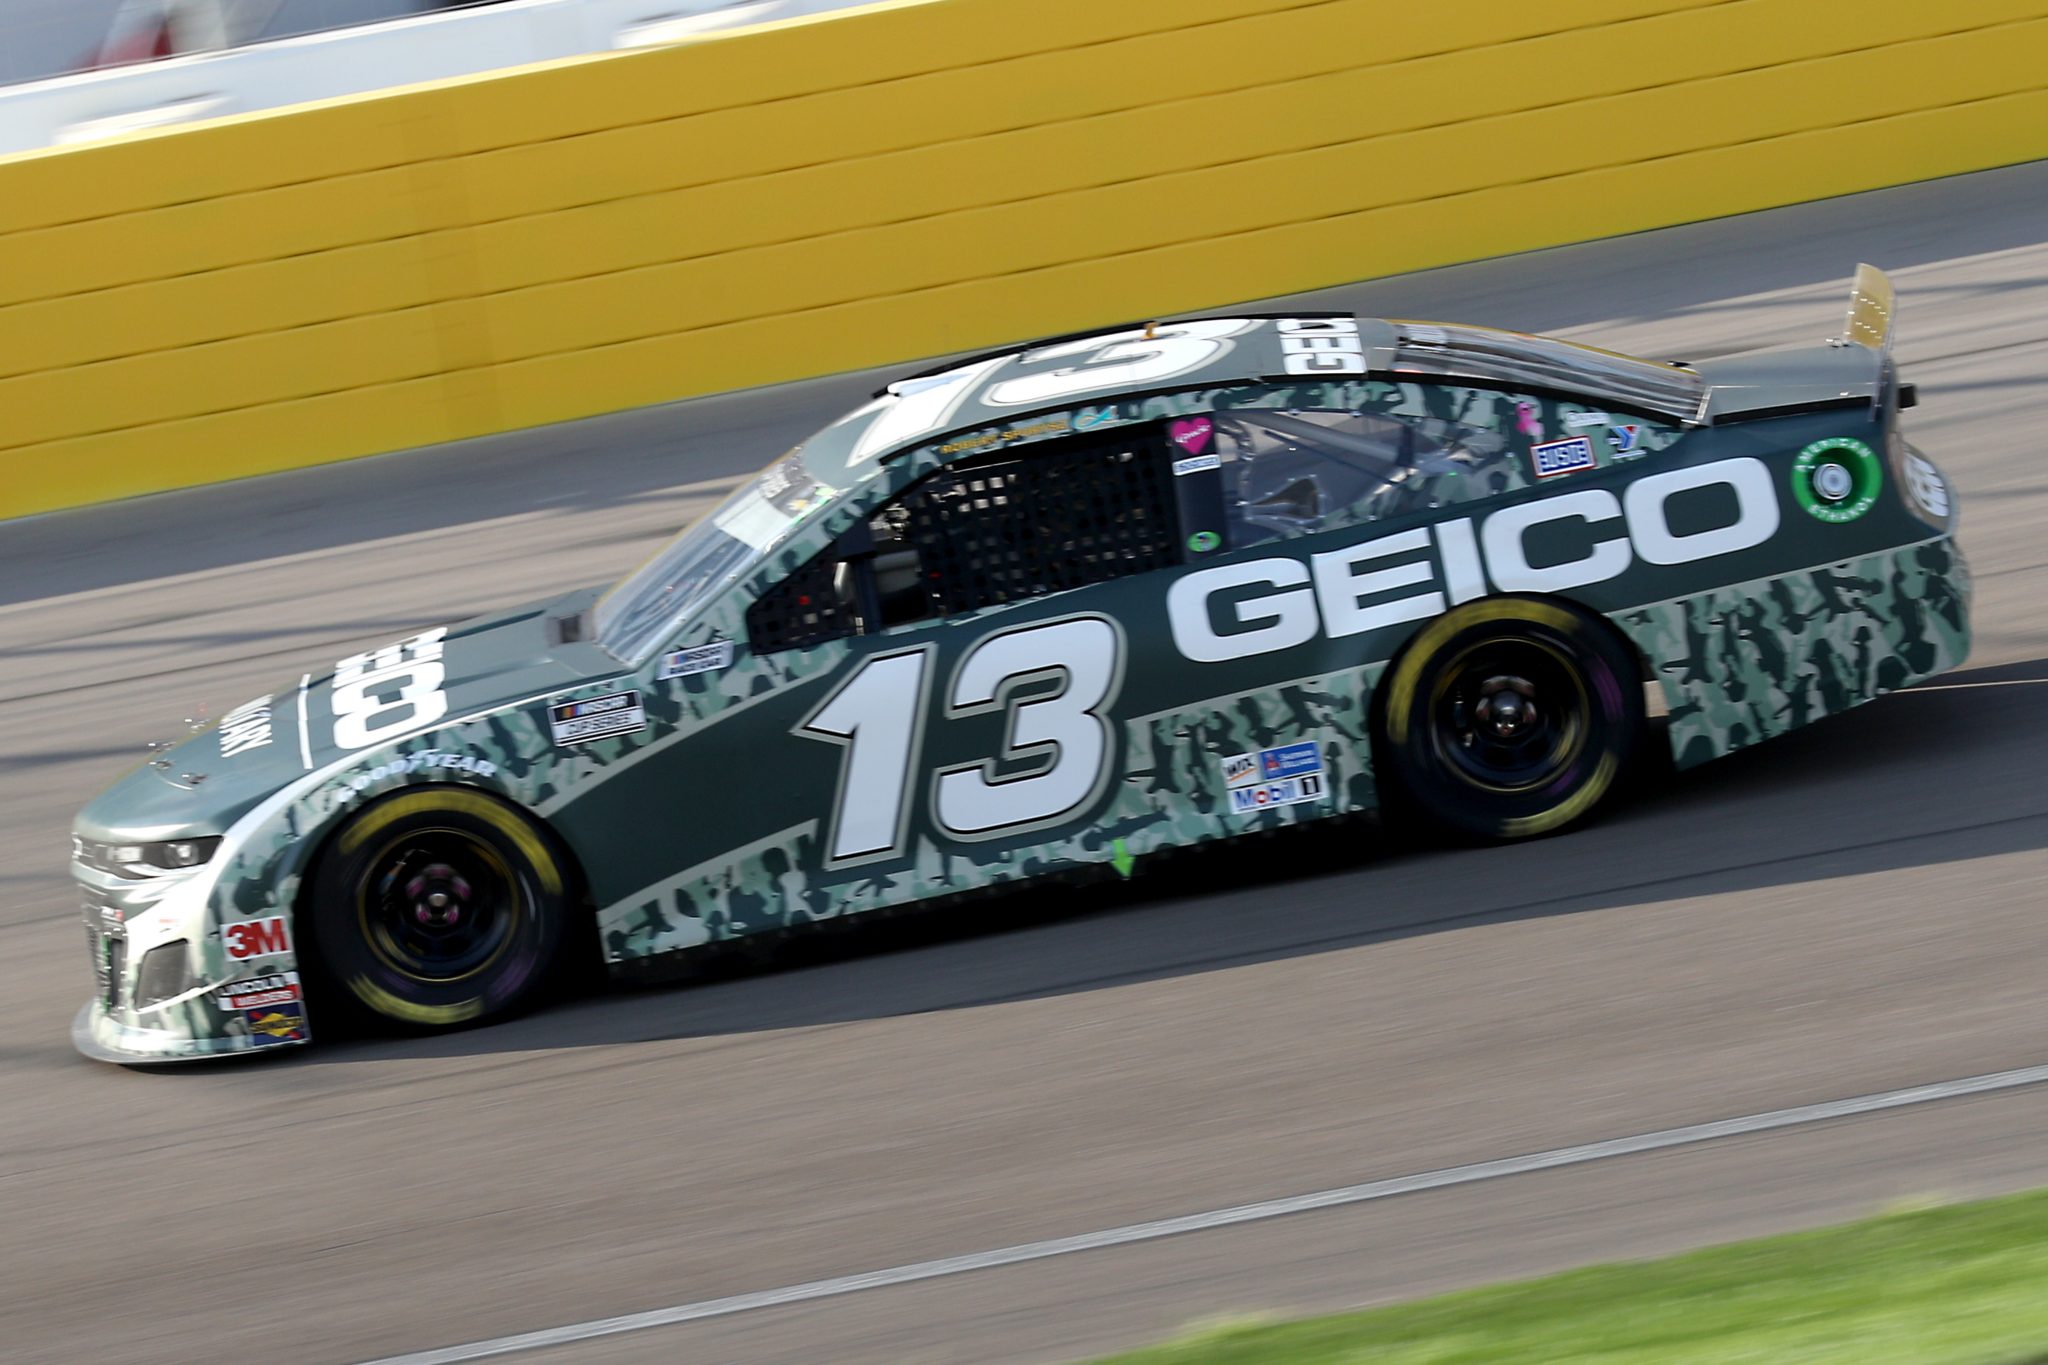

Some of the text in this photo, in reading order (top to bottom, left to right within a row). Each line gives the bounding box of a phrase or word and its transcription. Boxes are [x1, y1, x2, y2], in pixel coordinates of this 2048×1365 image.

[1794, 436, 1871, 473] AMERICAN
[1807, 497, 1876, 523] ETHANOL
[1166, 457, 1781, 663] GEICO
[577, 695, 629, 716] NASCAR
[592, 713, 632, 731] SERIES
[793, 613, 1124, 866] 13
[1233, 780, 1296, 809] Mobil
[227, 918, 288, 959] 3M
